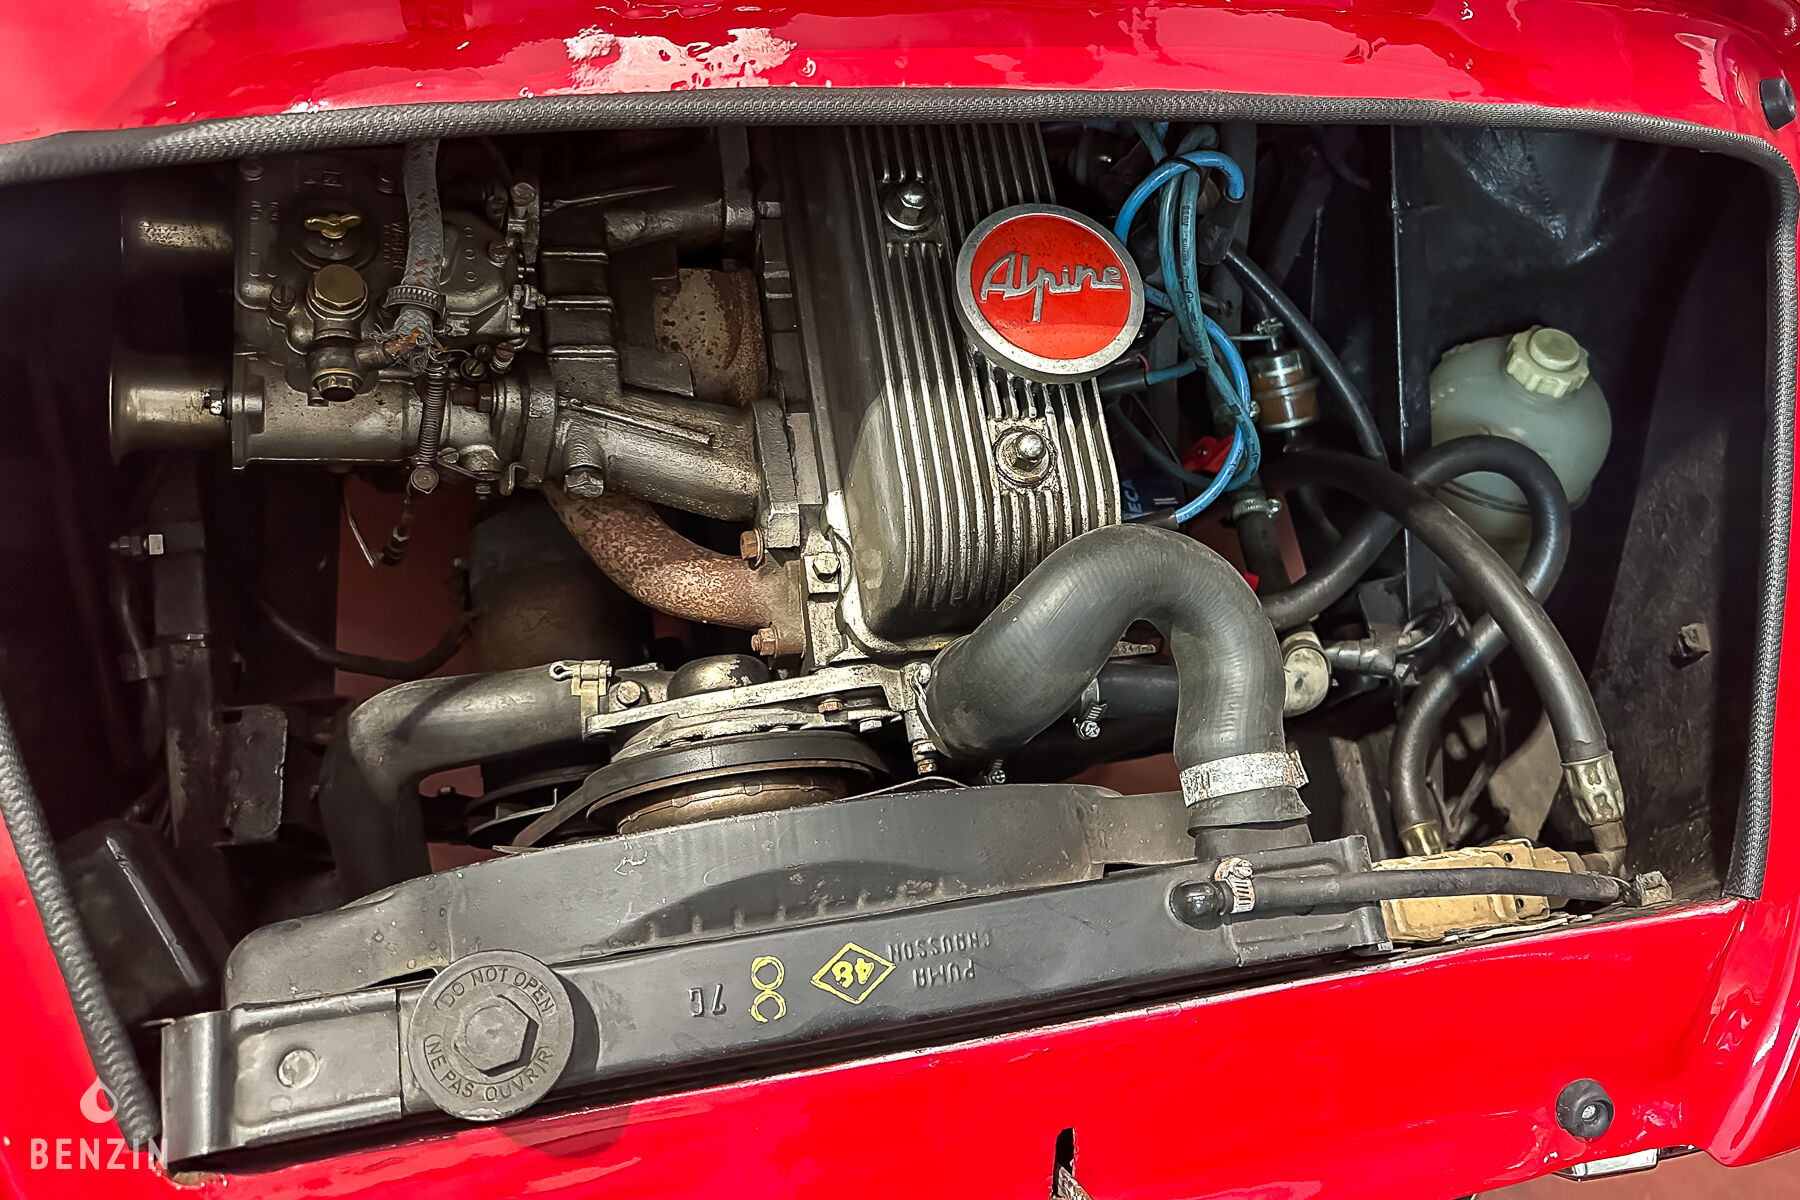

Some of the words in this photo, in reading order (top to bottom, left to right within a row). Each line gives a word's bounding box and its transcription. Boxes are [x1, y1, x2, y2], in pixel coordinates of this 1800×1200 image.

[980, 251, 1124, 323] Alpine
[886, 931, 992, 963] CHAUSSON
[436, 982, 465, 1010] DO
[471, 967, 508, 987] NOT
[514, 971, 555, 1013] OPEN
[912, 958, 978, 988] PUMA
[426, 1040, 447, 1070] NE
[440, 1070, 475, 1098] PAS
[485, 1049, 553, 1101] OUVRIR
